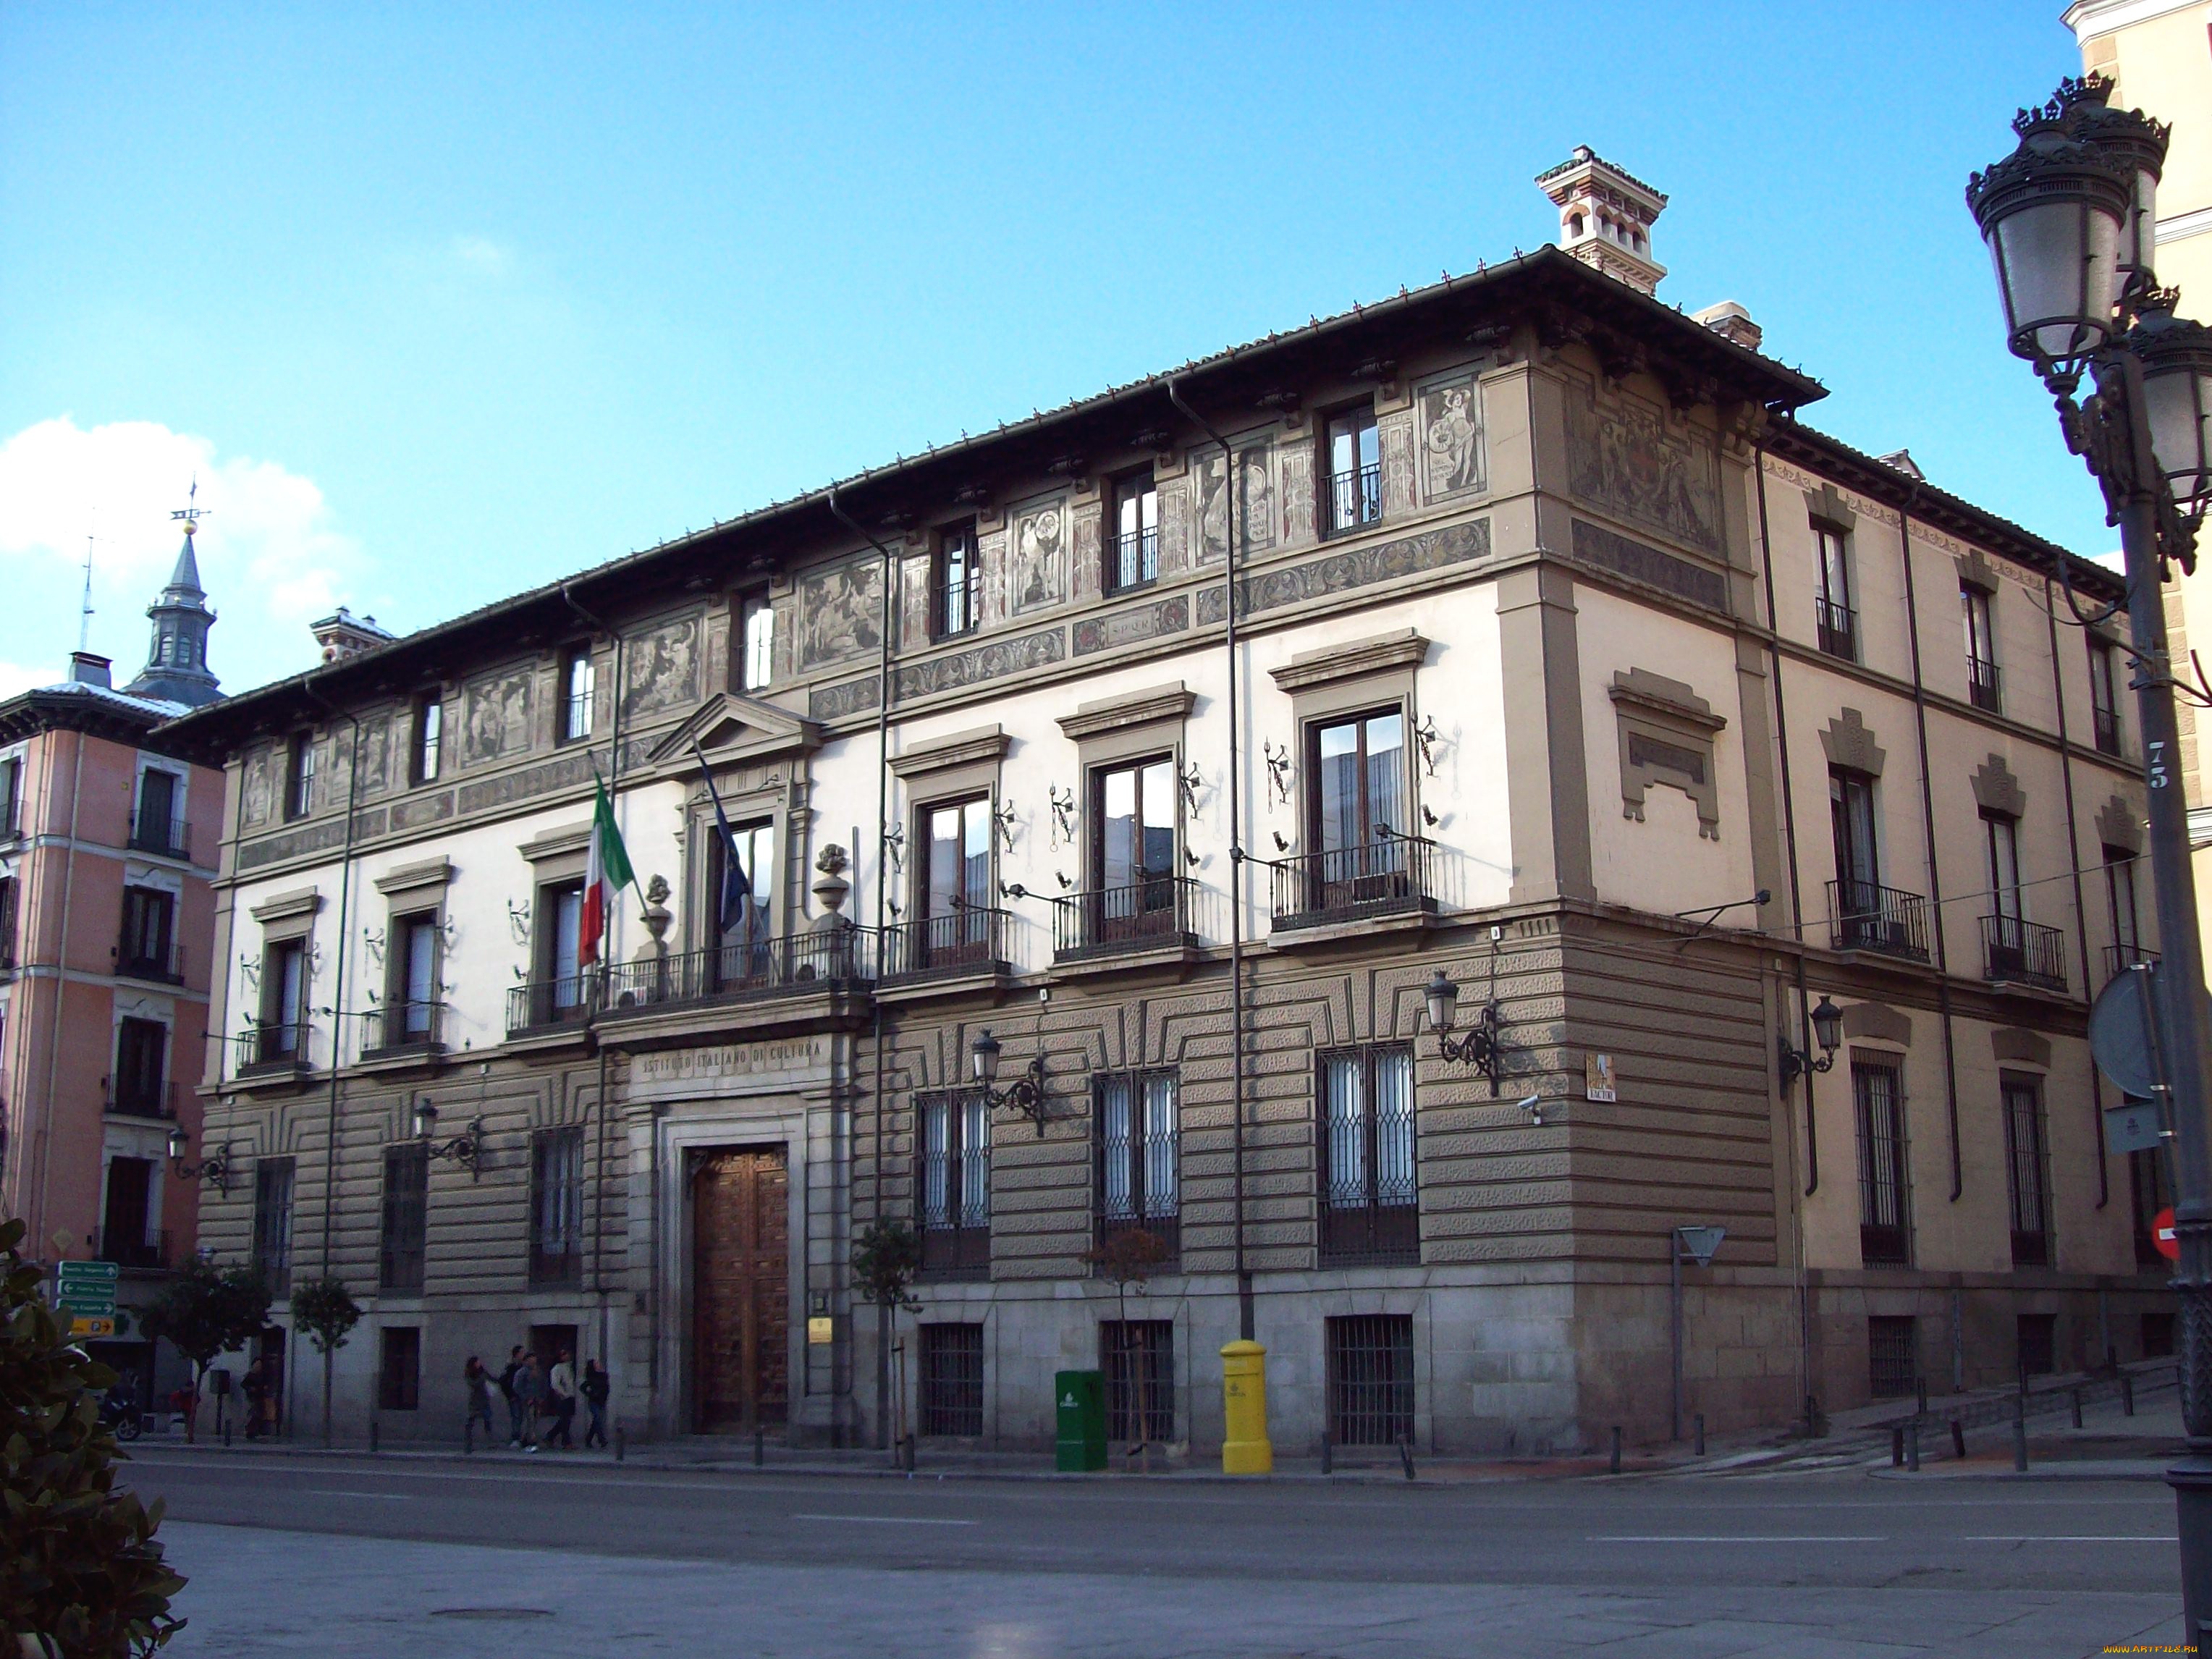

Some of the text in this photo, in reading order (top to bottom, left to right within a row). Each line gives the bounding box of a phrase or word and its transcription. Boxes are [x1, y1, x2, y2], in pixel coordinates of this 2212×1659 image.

[643, 1042, 820, 1073] ISTITUTO ITALIANO DI CULTURA
